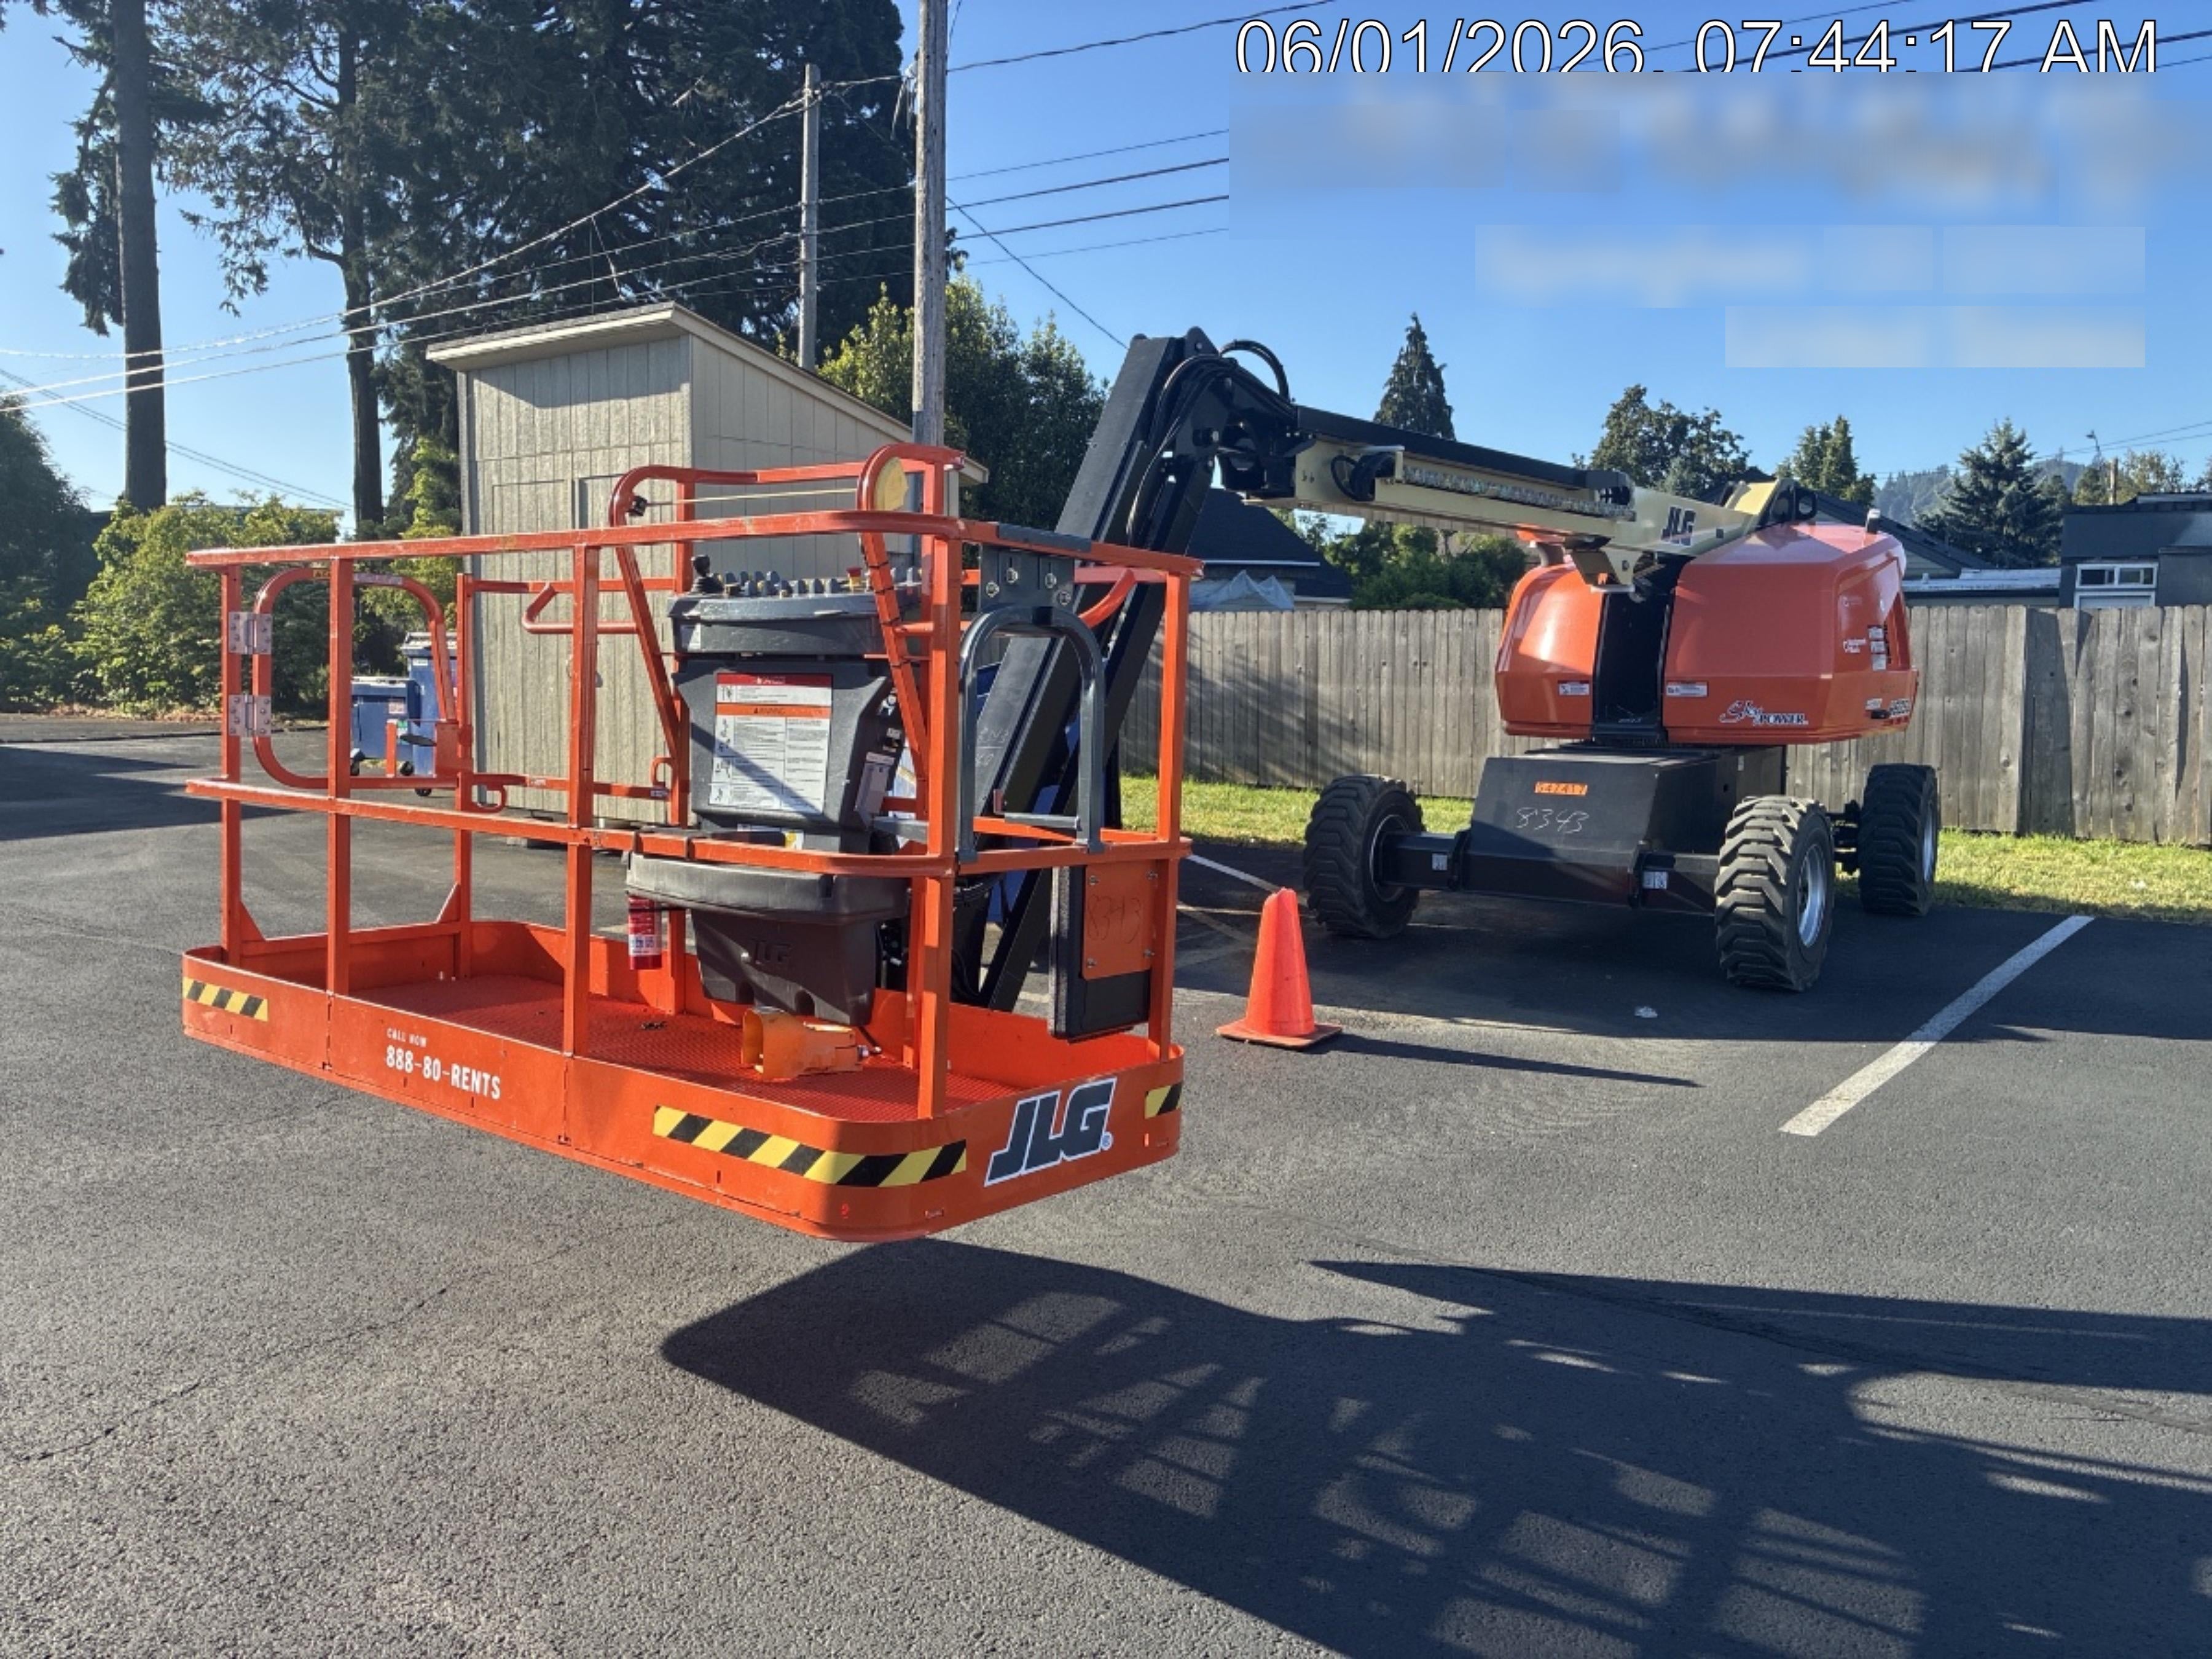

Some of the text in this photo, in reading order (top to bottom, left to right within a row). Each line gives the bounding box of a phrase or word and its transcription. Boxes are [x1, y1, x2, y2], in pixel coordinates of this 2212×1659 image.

[1661, 506, 1696, 546] JLG
[1516, 807, 1590, 834] 8343
[387, 1027, 426, 1048] CALL NOW
[386, 1045, 501, 1100] 888-80-RENTS
[984, 1077, 1117, 1187] JLG
